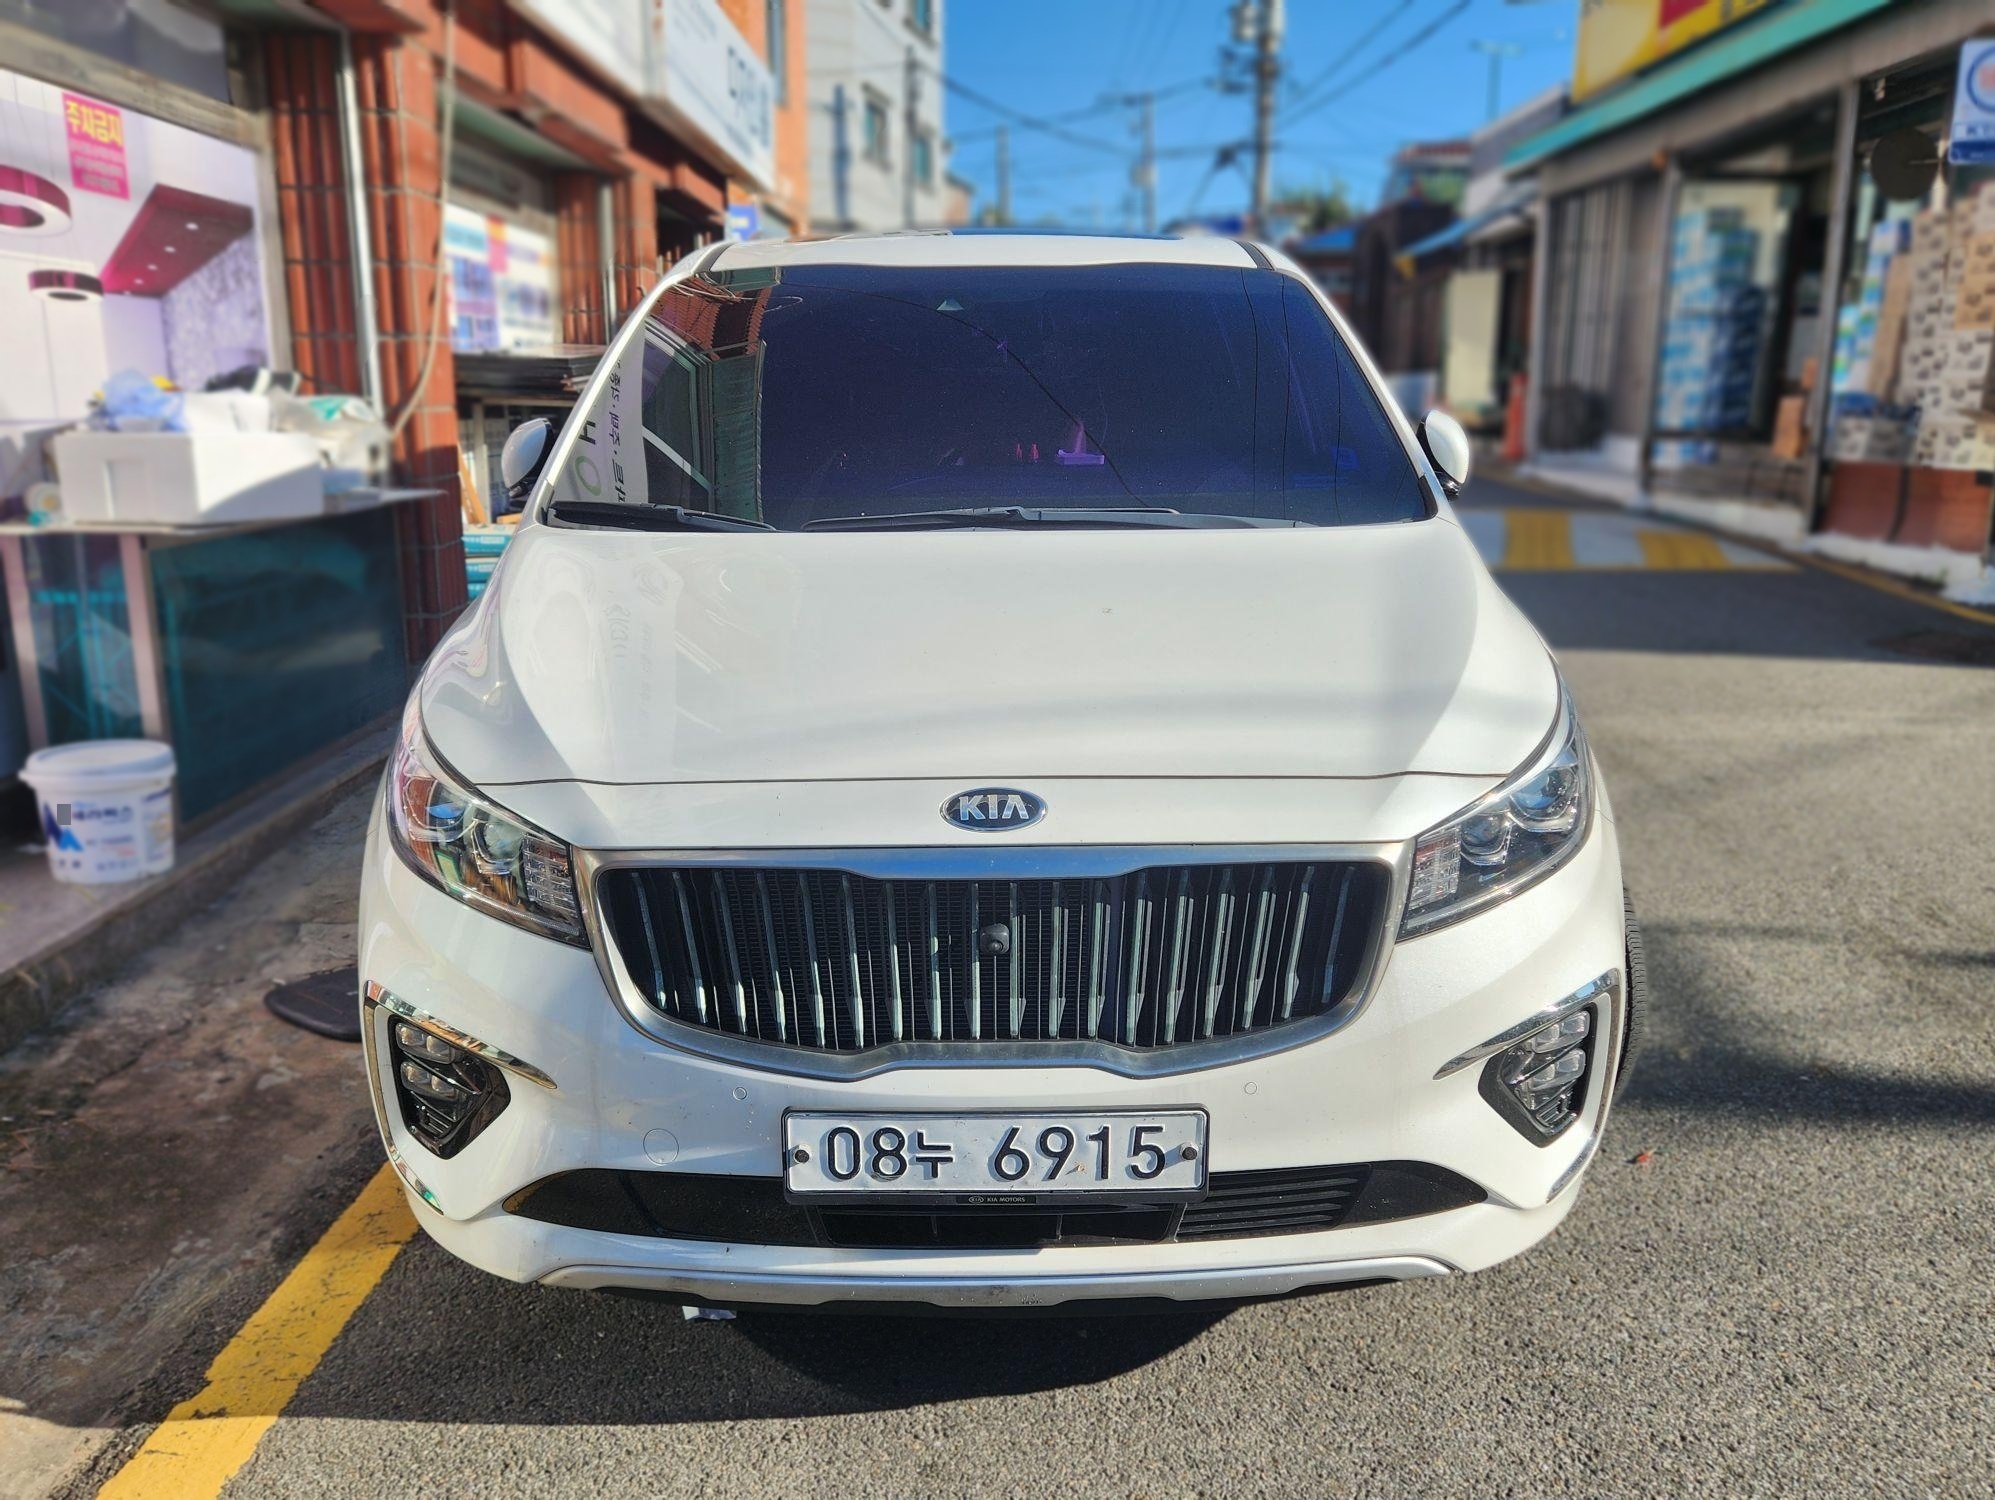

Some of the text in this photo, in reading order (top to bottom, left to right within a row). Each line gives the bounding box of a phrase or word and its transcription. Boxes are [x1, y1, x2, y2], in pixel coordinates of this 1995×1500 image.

[959, 794, 1029, 821] KIA
[826, 1124, 1168, 1182] 08누 6915
